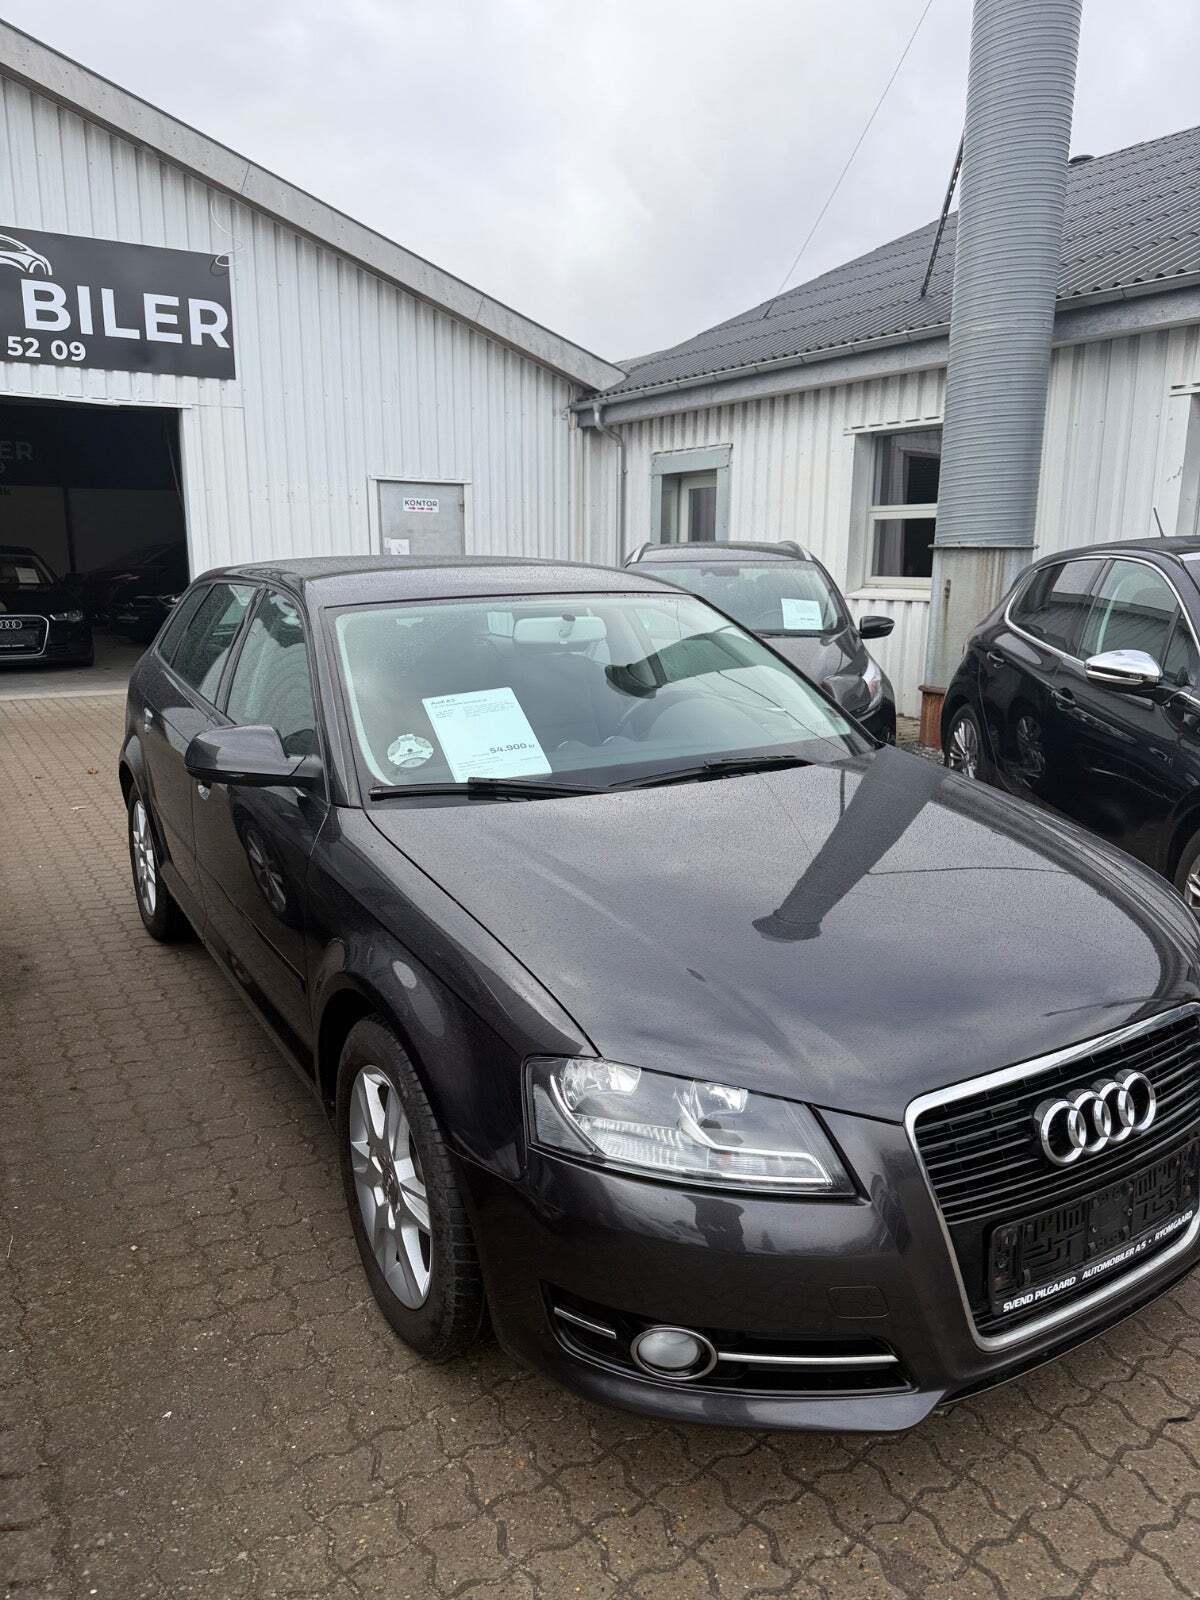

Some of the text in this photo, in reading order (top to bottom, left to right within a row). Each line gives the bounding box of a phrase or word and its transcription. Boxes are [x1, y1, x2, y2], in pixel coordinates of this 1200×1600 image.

[20, 278, 230, 349] BILER
[7, 336, 86, 362] 52 09
[404, 499, 438, 507] KONTOR
[489, 742, 527, 754] 54.900
[1002, 1293, 1034, 1313] SVEND
[1034, 1276, 1077, 1300] PILGAARD
[1081, 1246, 1135, 1280] AUTOMOBILER
